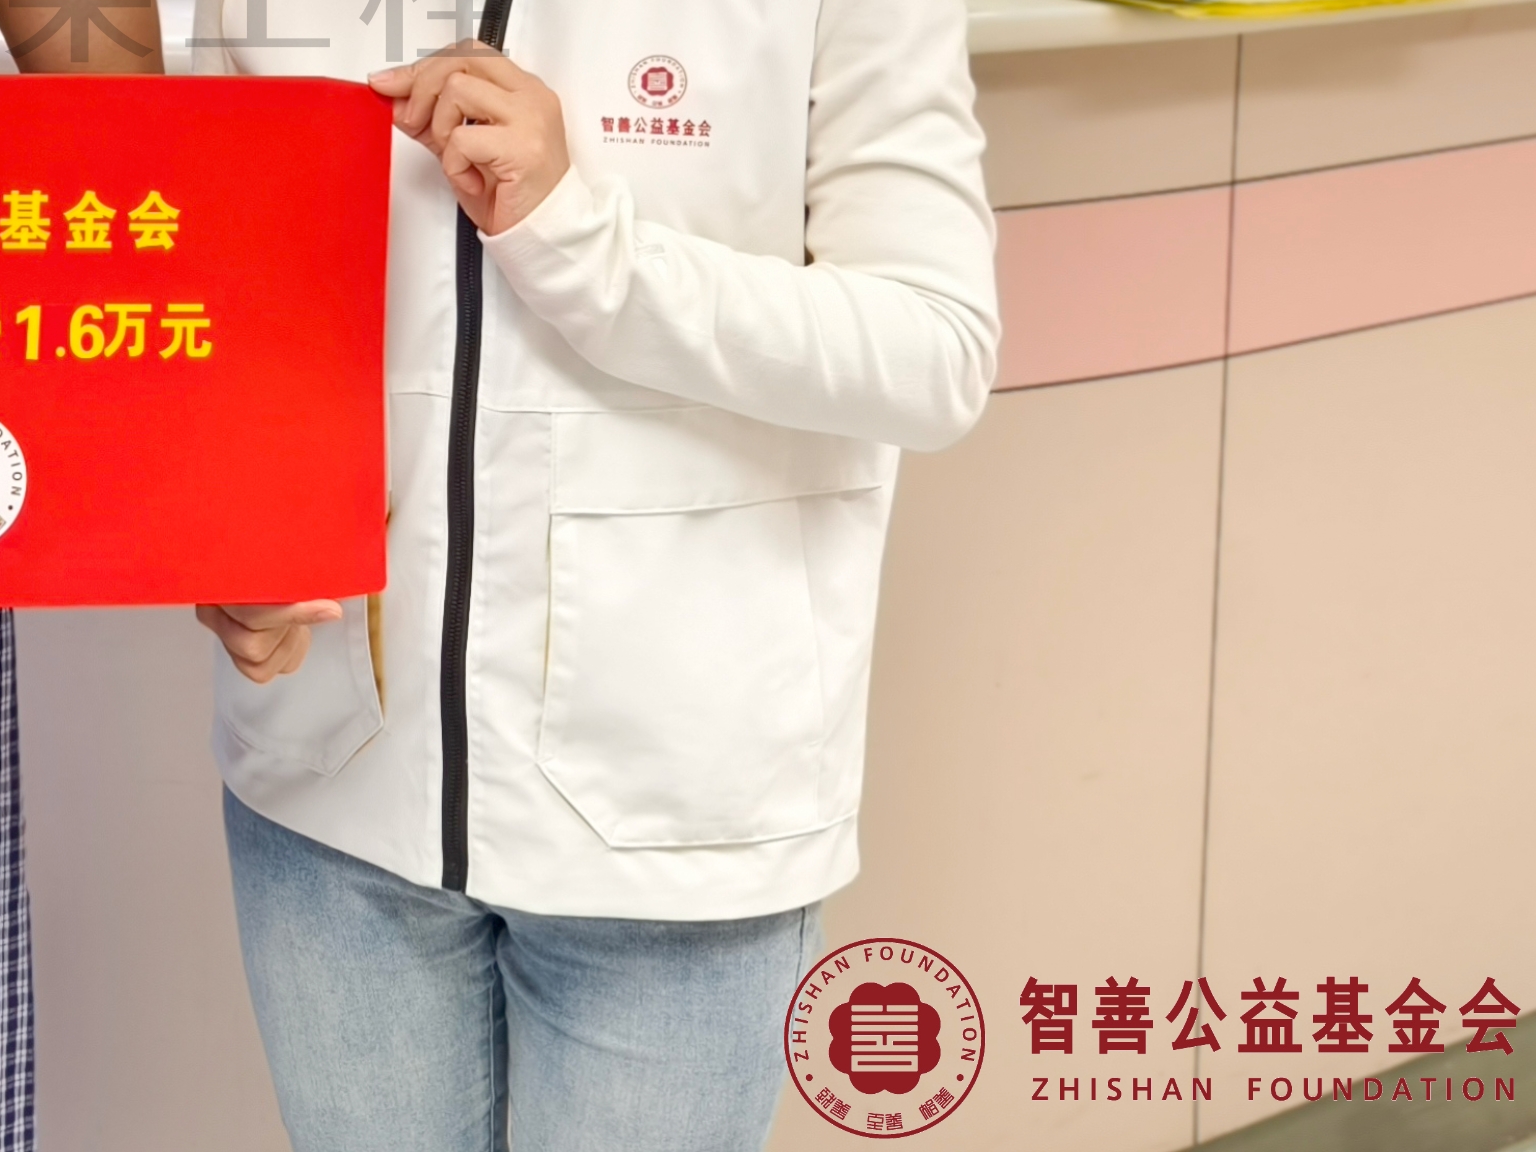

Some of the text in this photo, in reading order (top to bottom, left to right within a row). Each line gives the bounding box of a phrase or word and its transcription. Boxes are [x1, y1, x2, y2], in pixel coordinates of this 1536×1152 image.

[600, 116, 712, 138] 智善公益基金会
[602, 136, 711, 148] ZHISHAN FOUNDATION
